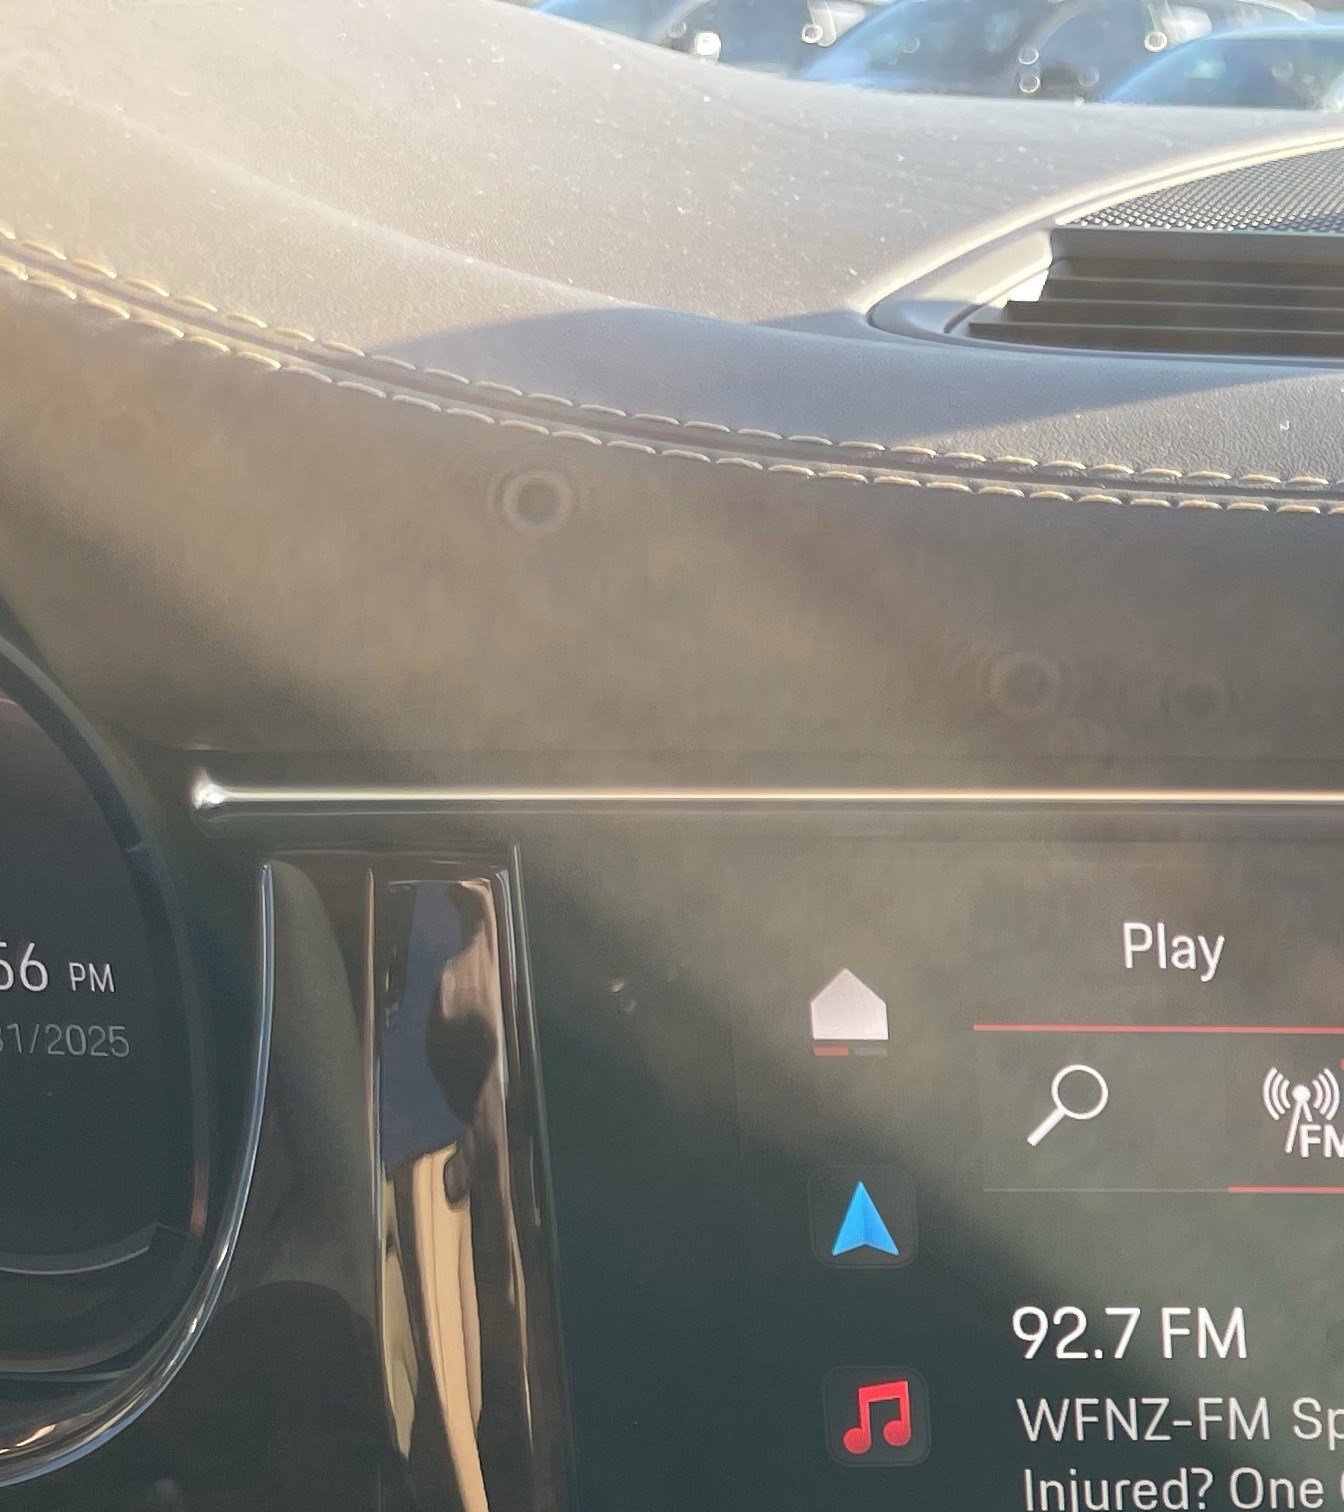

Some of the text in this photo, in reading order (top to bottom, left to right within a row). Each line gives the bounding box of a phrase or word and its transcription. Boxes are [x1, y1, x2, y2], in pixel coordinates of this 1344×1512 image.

[1122, 922, 1225, 983] Play
[69, 962, 115, 993] PM
[0, 1022, 130, 1058] 1/2025
[1011, 1306, 1247, 1359] 92.7 FM
[1016, 1397, 1271, 1442] WFNZ-FM
[1229, 1467, 1325, 1510] One
